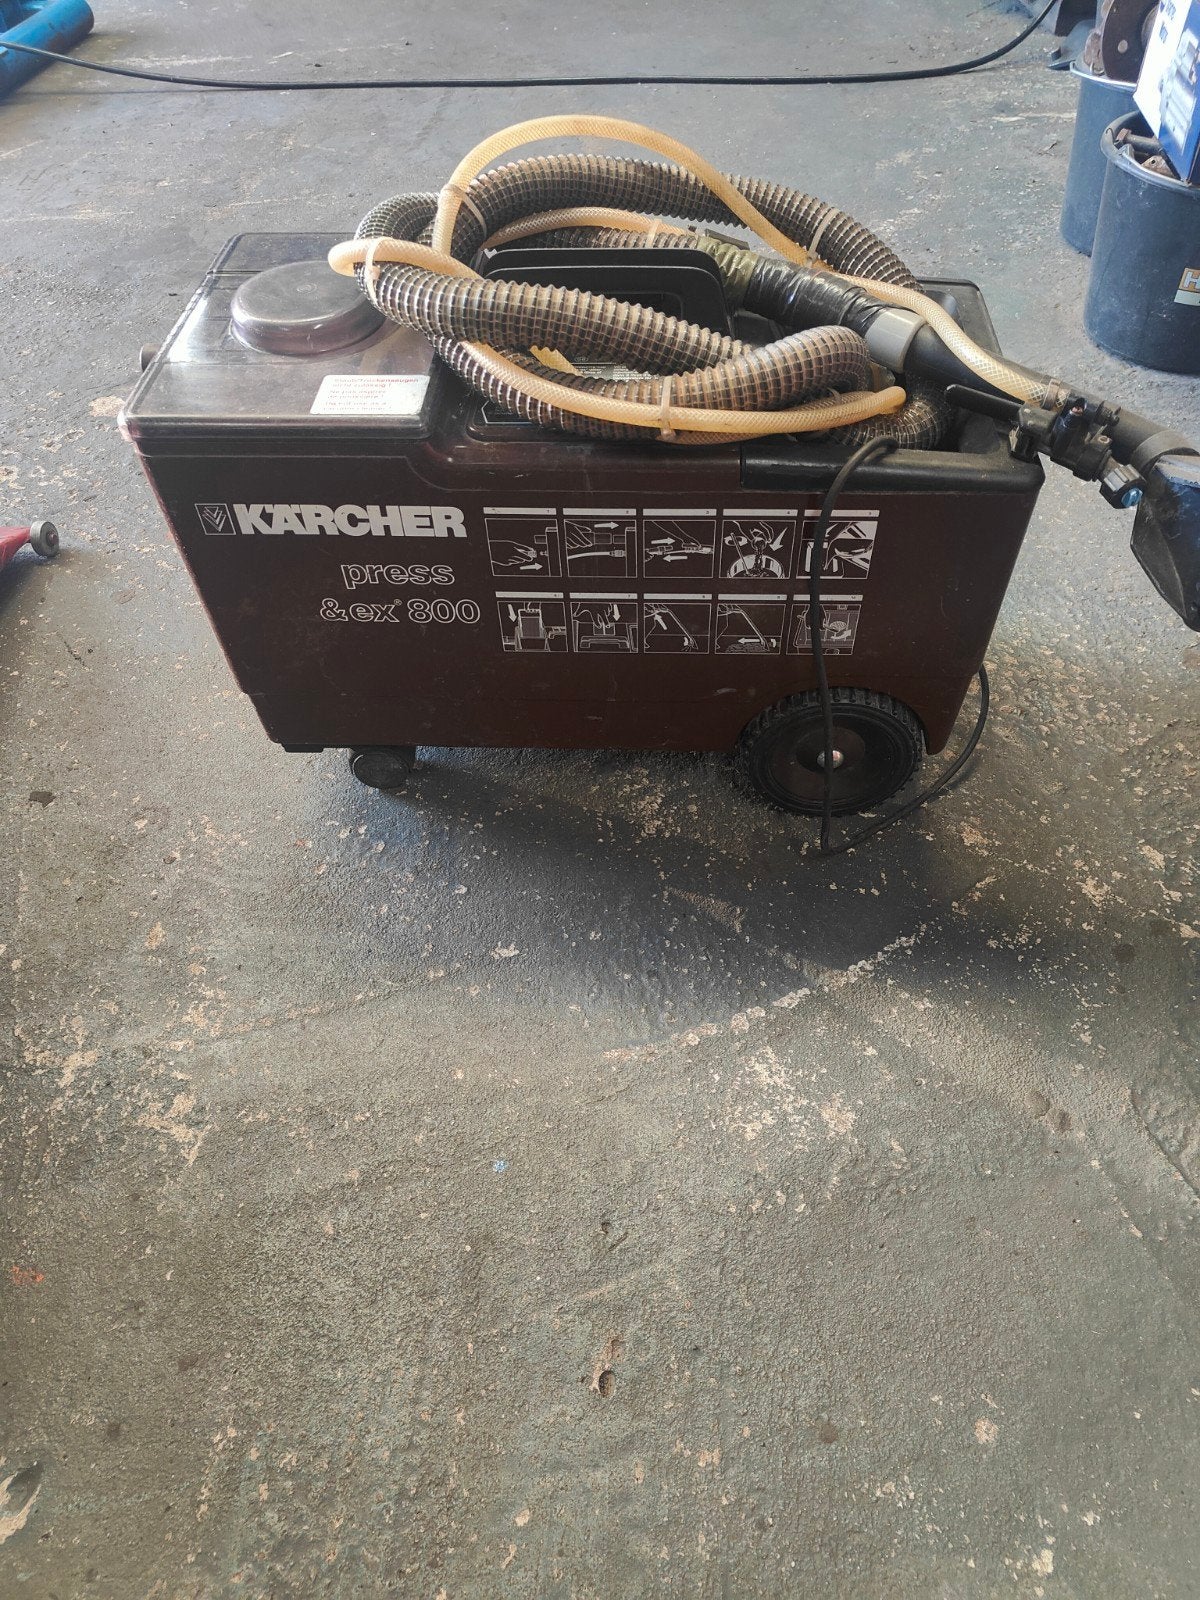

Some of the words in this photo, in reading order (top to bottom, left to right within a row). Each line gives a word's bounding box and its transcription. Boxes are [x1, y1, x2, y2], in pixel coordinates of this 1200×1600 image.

[233, 503, 467, 538] KÄRCHER
[340, 564, 455, 590] press
[407, 598, 481, 624] 800
